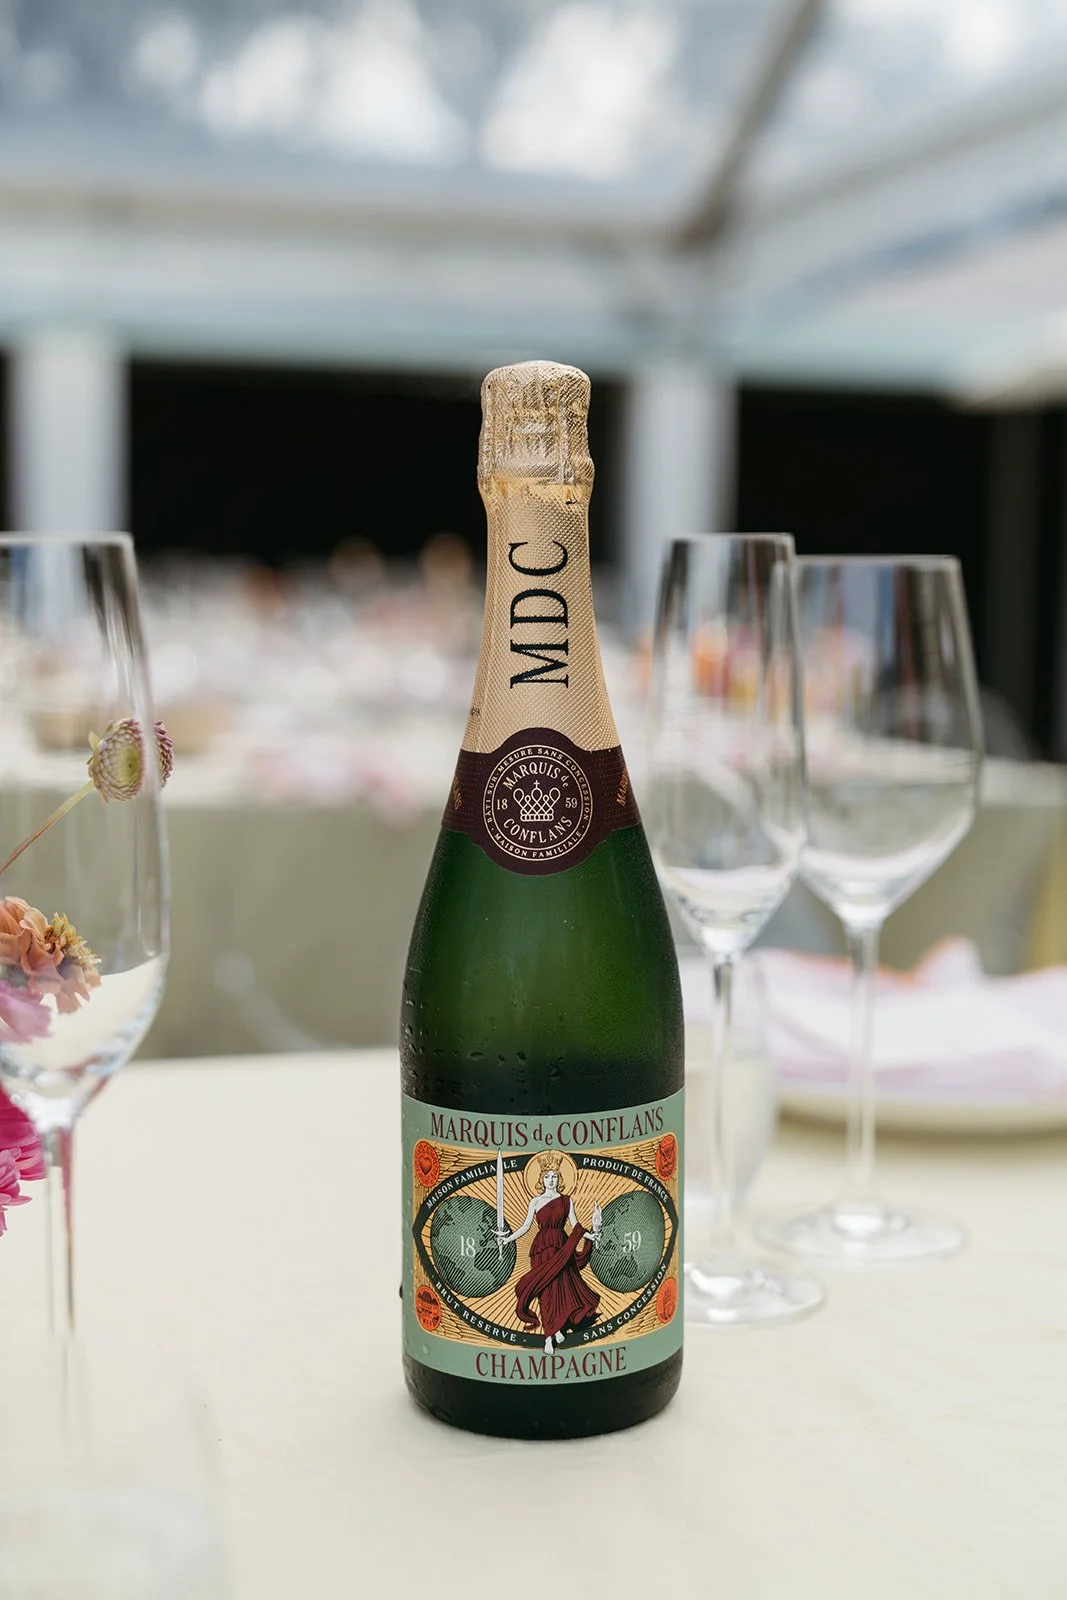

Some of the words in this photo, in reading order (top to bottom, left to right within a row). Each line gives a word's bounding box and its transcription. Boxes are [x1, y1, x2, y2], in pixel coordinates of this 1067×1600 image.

[508, 540, 569, 688] MDC
[502, 762, 561, 790] MARQUIS
[560, 775, 570, 788] de
[537, 748, 563, 760] SANS
[565, 760, 590, 820] CONCESSION
[497, 798, 508, 810] 18
[565, 797, 578, 809] 59
[493, 833, 528, 857] MAISON
[532, 831, 581, 858] FAMILIALE
[503, 816, 572, 843] CONFLANS
[430, 1111, 529, 1147] MARQUIS
[533, 1123, 553, 1146] de
[557, 1106, 664, 1146] CONFLANS
[426, 1181, 454, 1209] MAISON
[454, 1159, 518, 1186] FAMILIALE
[583, 1157, 630, 1173] PRODUIT
[631, 1169, 643, 1180] DE
[644, 1176, 669, 1203] FRANCE
[460, 1235, 476, 1258] 18
[622, 1230, 642, 1253] 59
[435, 1281, 461, 1310] BRUT
[462, 1310, 517, 1342] RESERVE
[583, 1322, 613, 1341] SANS
[616, 1263, 667, 1325] CONCESSION
[475, 1346, 627, 1380] CHAMPAGNE
